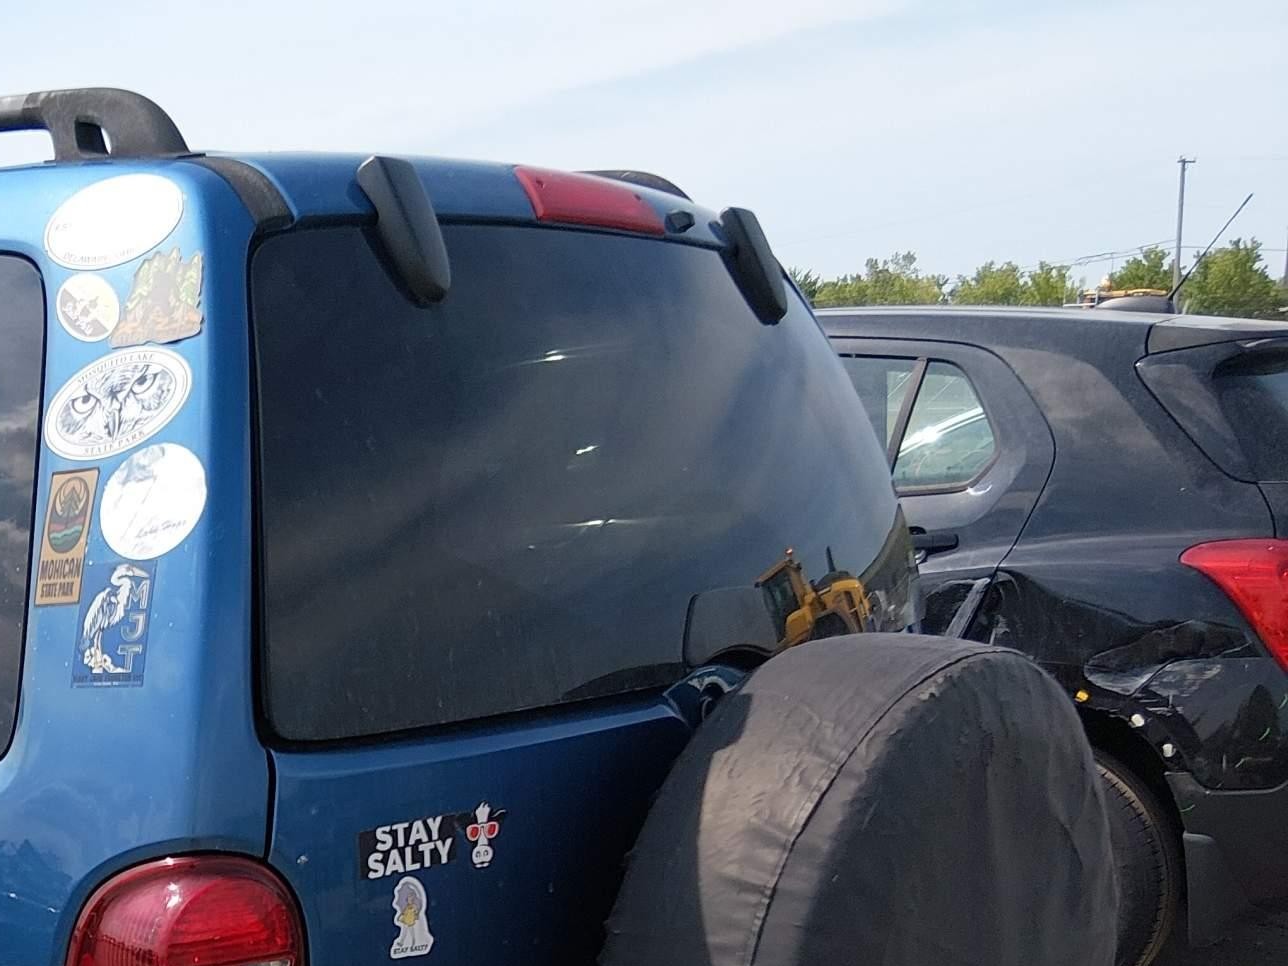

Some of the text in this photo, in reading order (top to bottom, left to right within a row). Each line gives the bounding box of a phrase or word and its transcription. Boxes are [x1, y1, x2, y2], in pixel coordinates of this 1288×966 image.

[40, 558, 82, 581] MOHICAN
[40, 582, 74, 598] STATE PARK
[375, 816, 442, 852] STAY
[367, 838, 453, 880] SALTY
[393, 943, 428, 955] STAY SALTY
